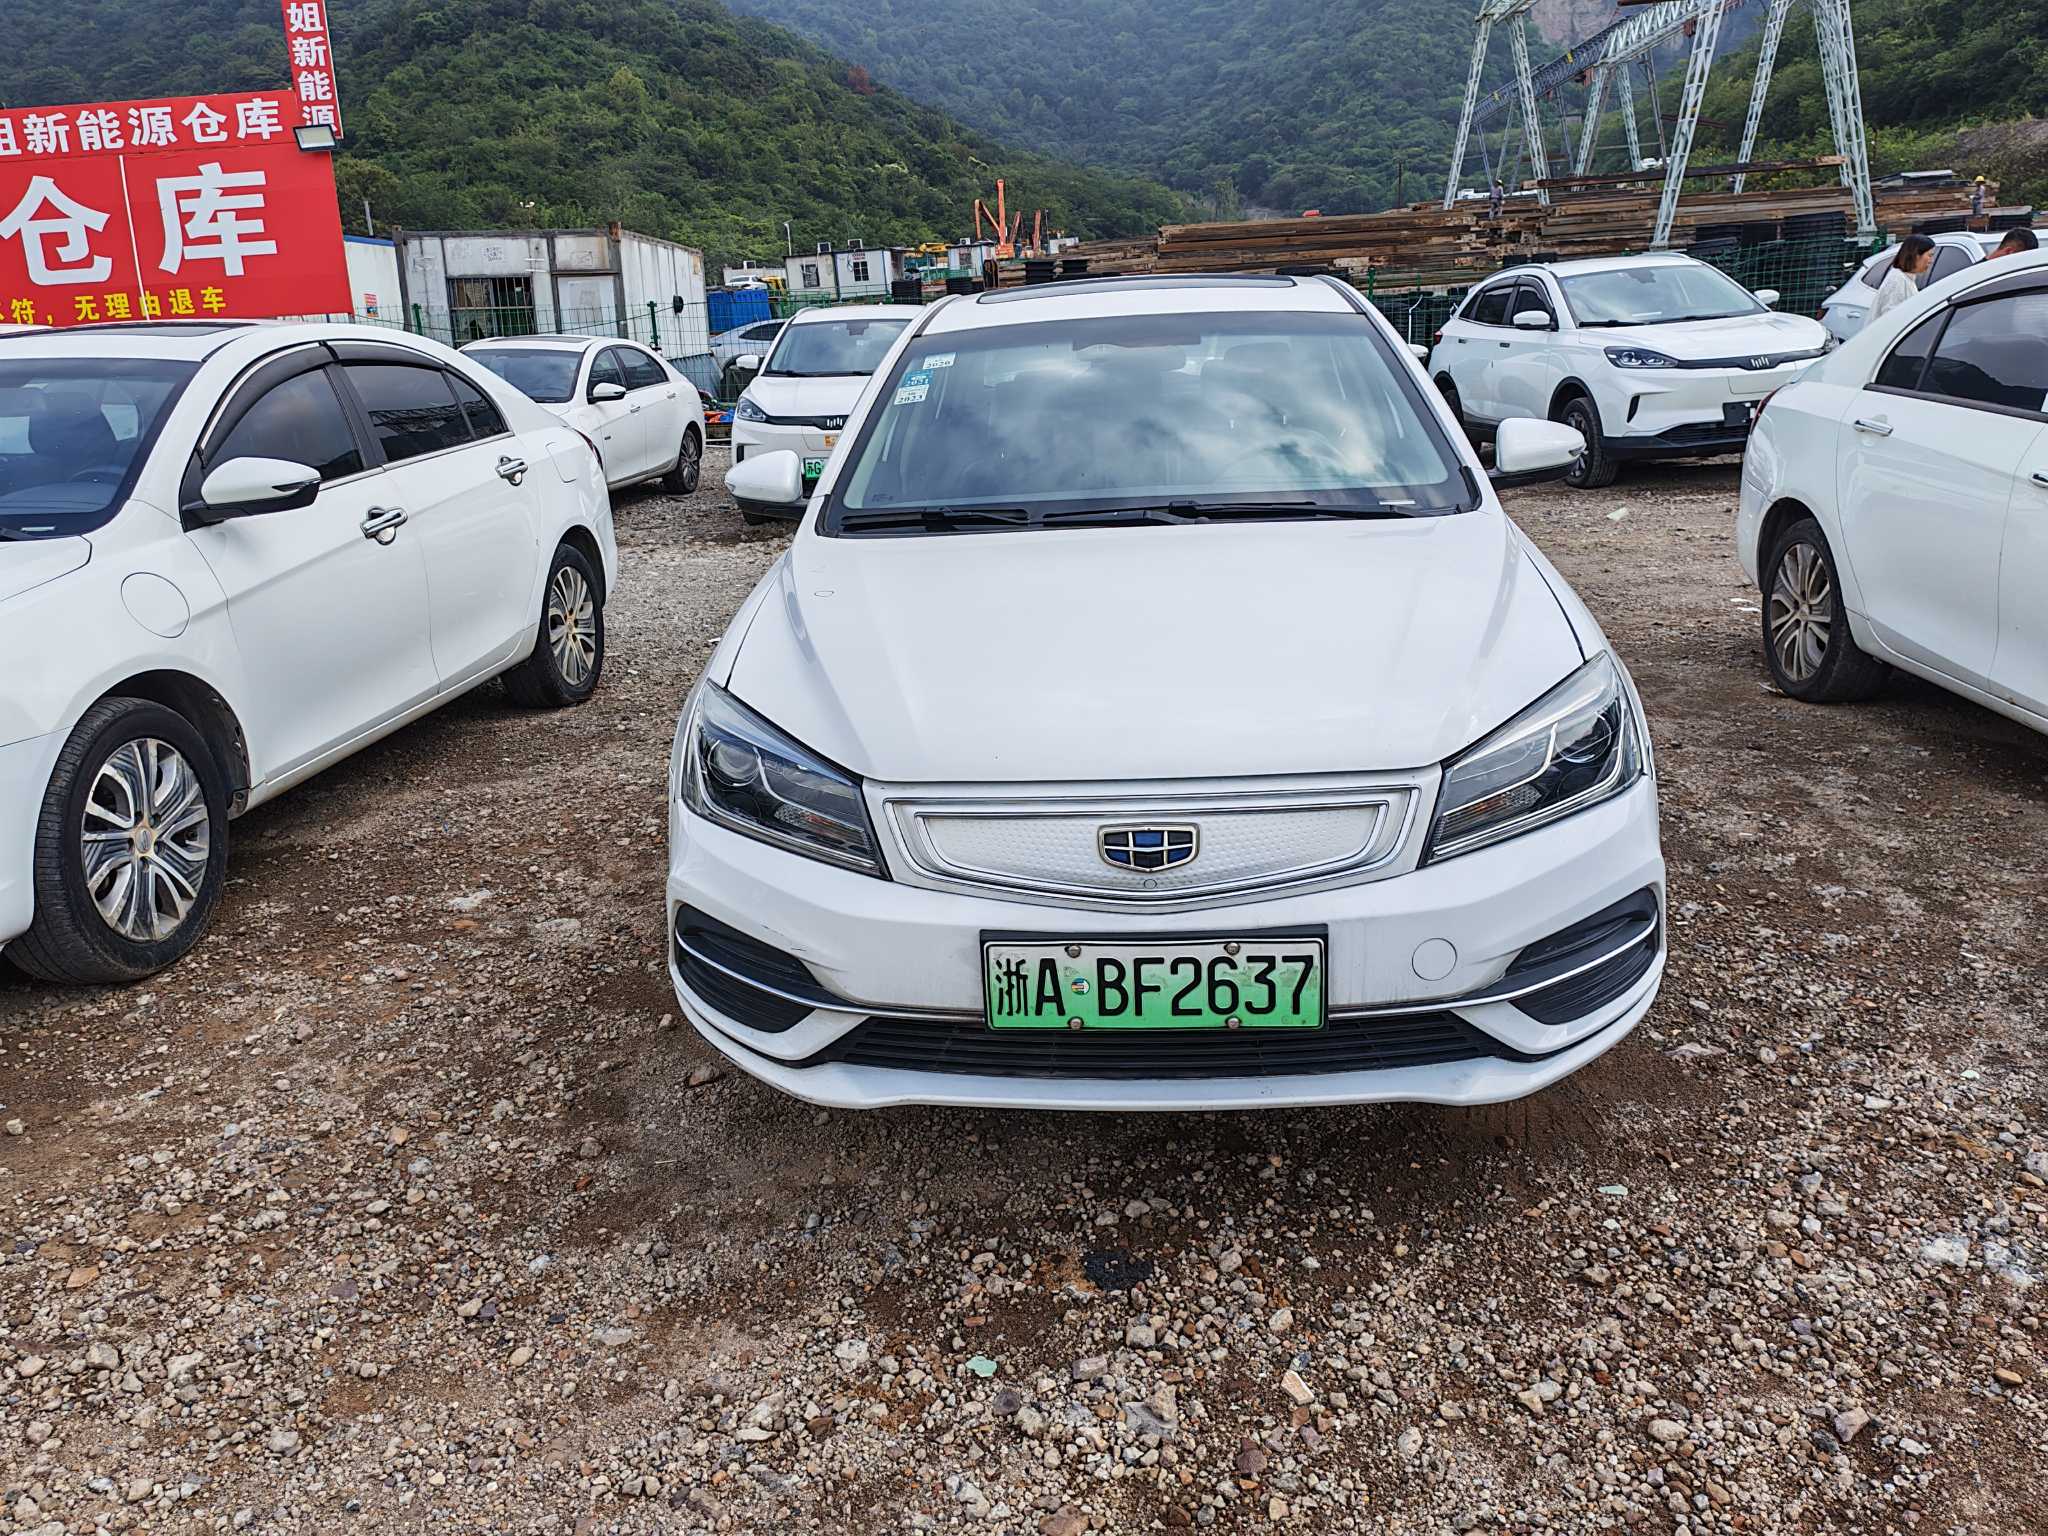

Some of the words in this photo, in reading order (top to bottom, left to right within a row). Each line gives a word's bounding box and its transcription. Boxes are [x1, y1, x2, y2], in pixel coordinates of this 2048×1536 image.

[286, 2, 338, 132] 姐新能源
[0, 162, 278, 286] 仓库
[0, 286, 227, 326] 符，无理由退车
